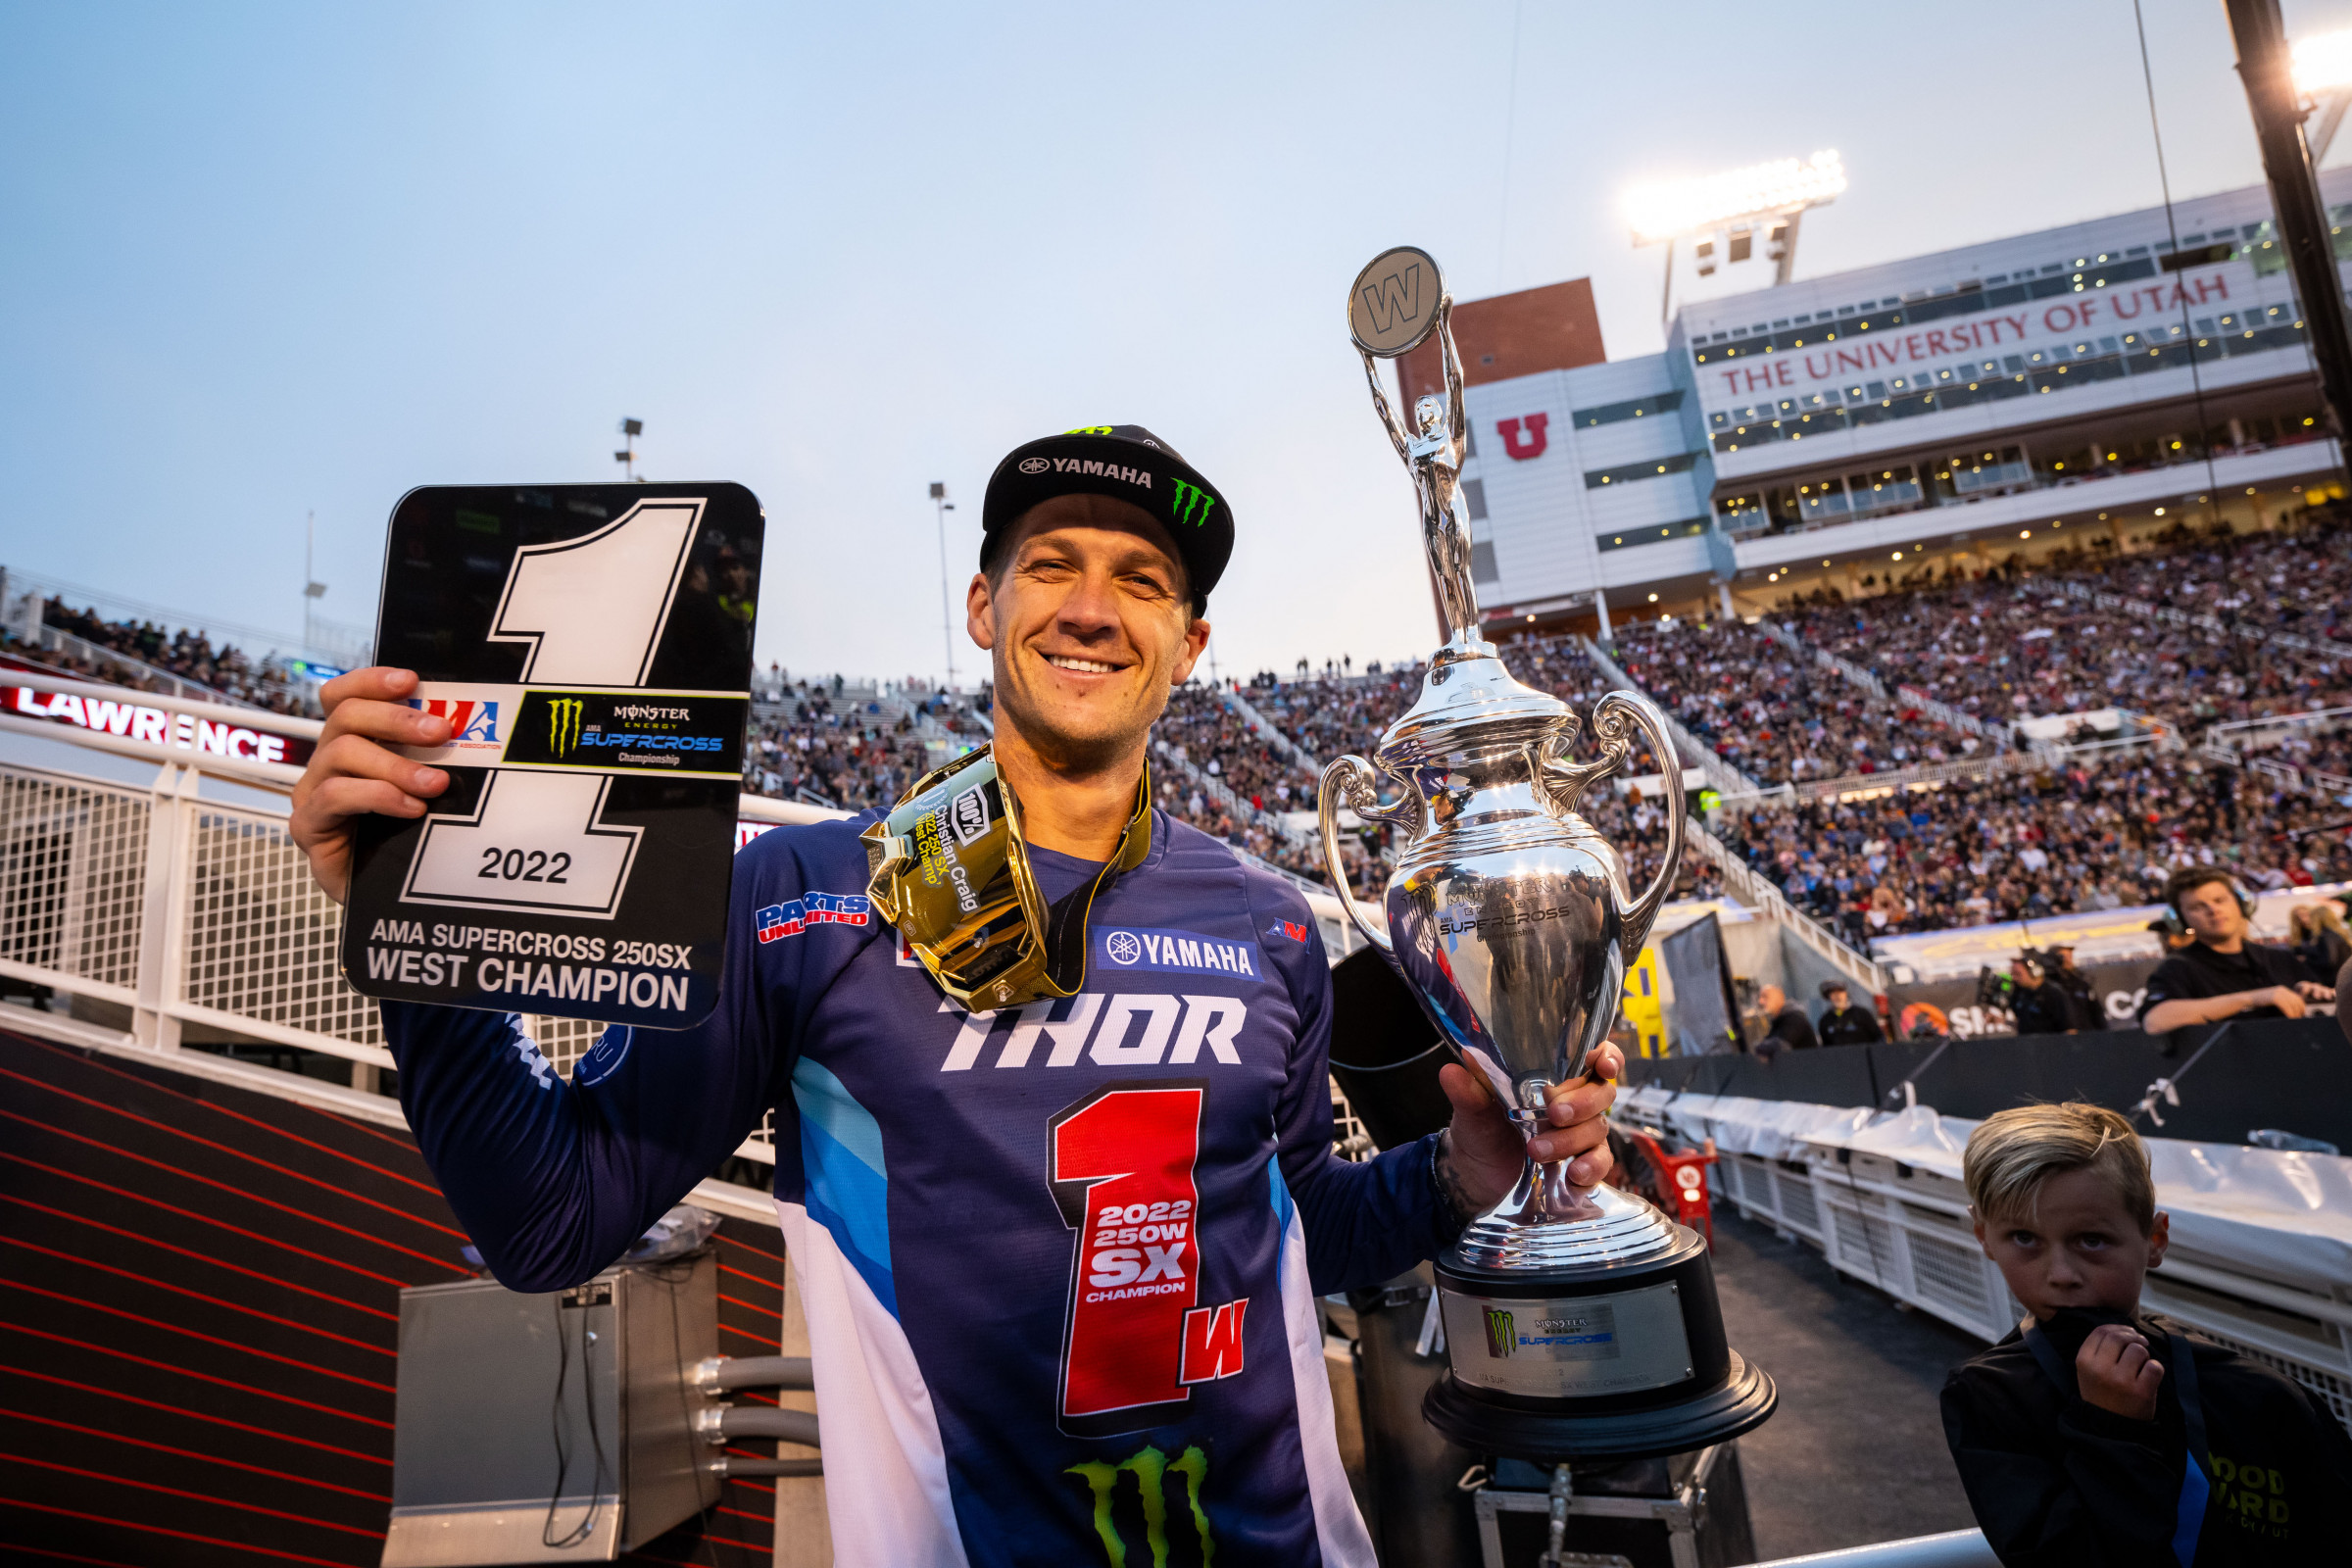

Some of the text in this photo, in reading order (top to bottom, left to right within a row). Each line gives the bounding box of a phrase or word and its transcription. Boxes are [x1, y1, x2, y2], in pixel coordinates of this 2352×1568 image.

[1362, 263, 1419, 334] W
[1722, 273, 2232, 396] THE UNIVERSITY OF UTAH
[1496, 411, 1548, 461] U
[1053, 458, 1152, 489] YAMAHA
[17, 687, 286, 763] LAWRENCE
[399, 497, 708, 920] 1
[407, 699, 502, 742] MA
[624, 721, 678, 730] ENERGY
[580, 732, 724, 752] SUPERCROSS
[618, 752, 680, 765] Championship
[915, 813, 926, 841] West
[958, 793, 985, 834] 100%
[478, 847, 572, 884] 2022
[928, 835, 943, 856] 250
[935, 805, 978, 911] Christian Craig
[935, 856, 950, 876] SX
[756, 891, 870, 930] PARTS
[759, 910, 869, 944] UNLITED
[1440, 906, 1570, 935] SUPERCROSS
[370, 918, 693, 970] AMA SUPERCROSS 250SX
[1142, 933, 1254, 976] YAMAHA
[368, 947, 690, 1012] WEST CHAMPION
[938, 993, 1248, 1072] THOR
[1097, 1200, 1192, 1227] 2022
[1054, 1088, 1203, 1417] 1
[1094, 1222, 1188, 1248] 250W
[1089, 1242, 1187, 1288] SX
[1086, 1281, 1186, 1303] CHAMPION
[1179, 1298, 1250, 1386] W
[1518, 1333, 1612, 1346] SUPERCROSS
